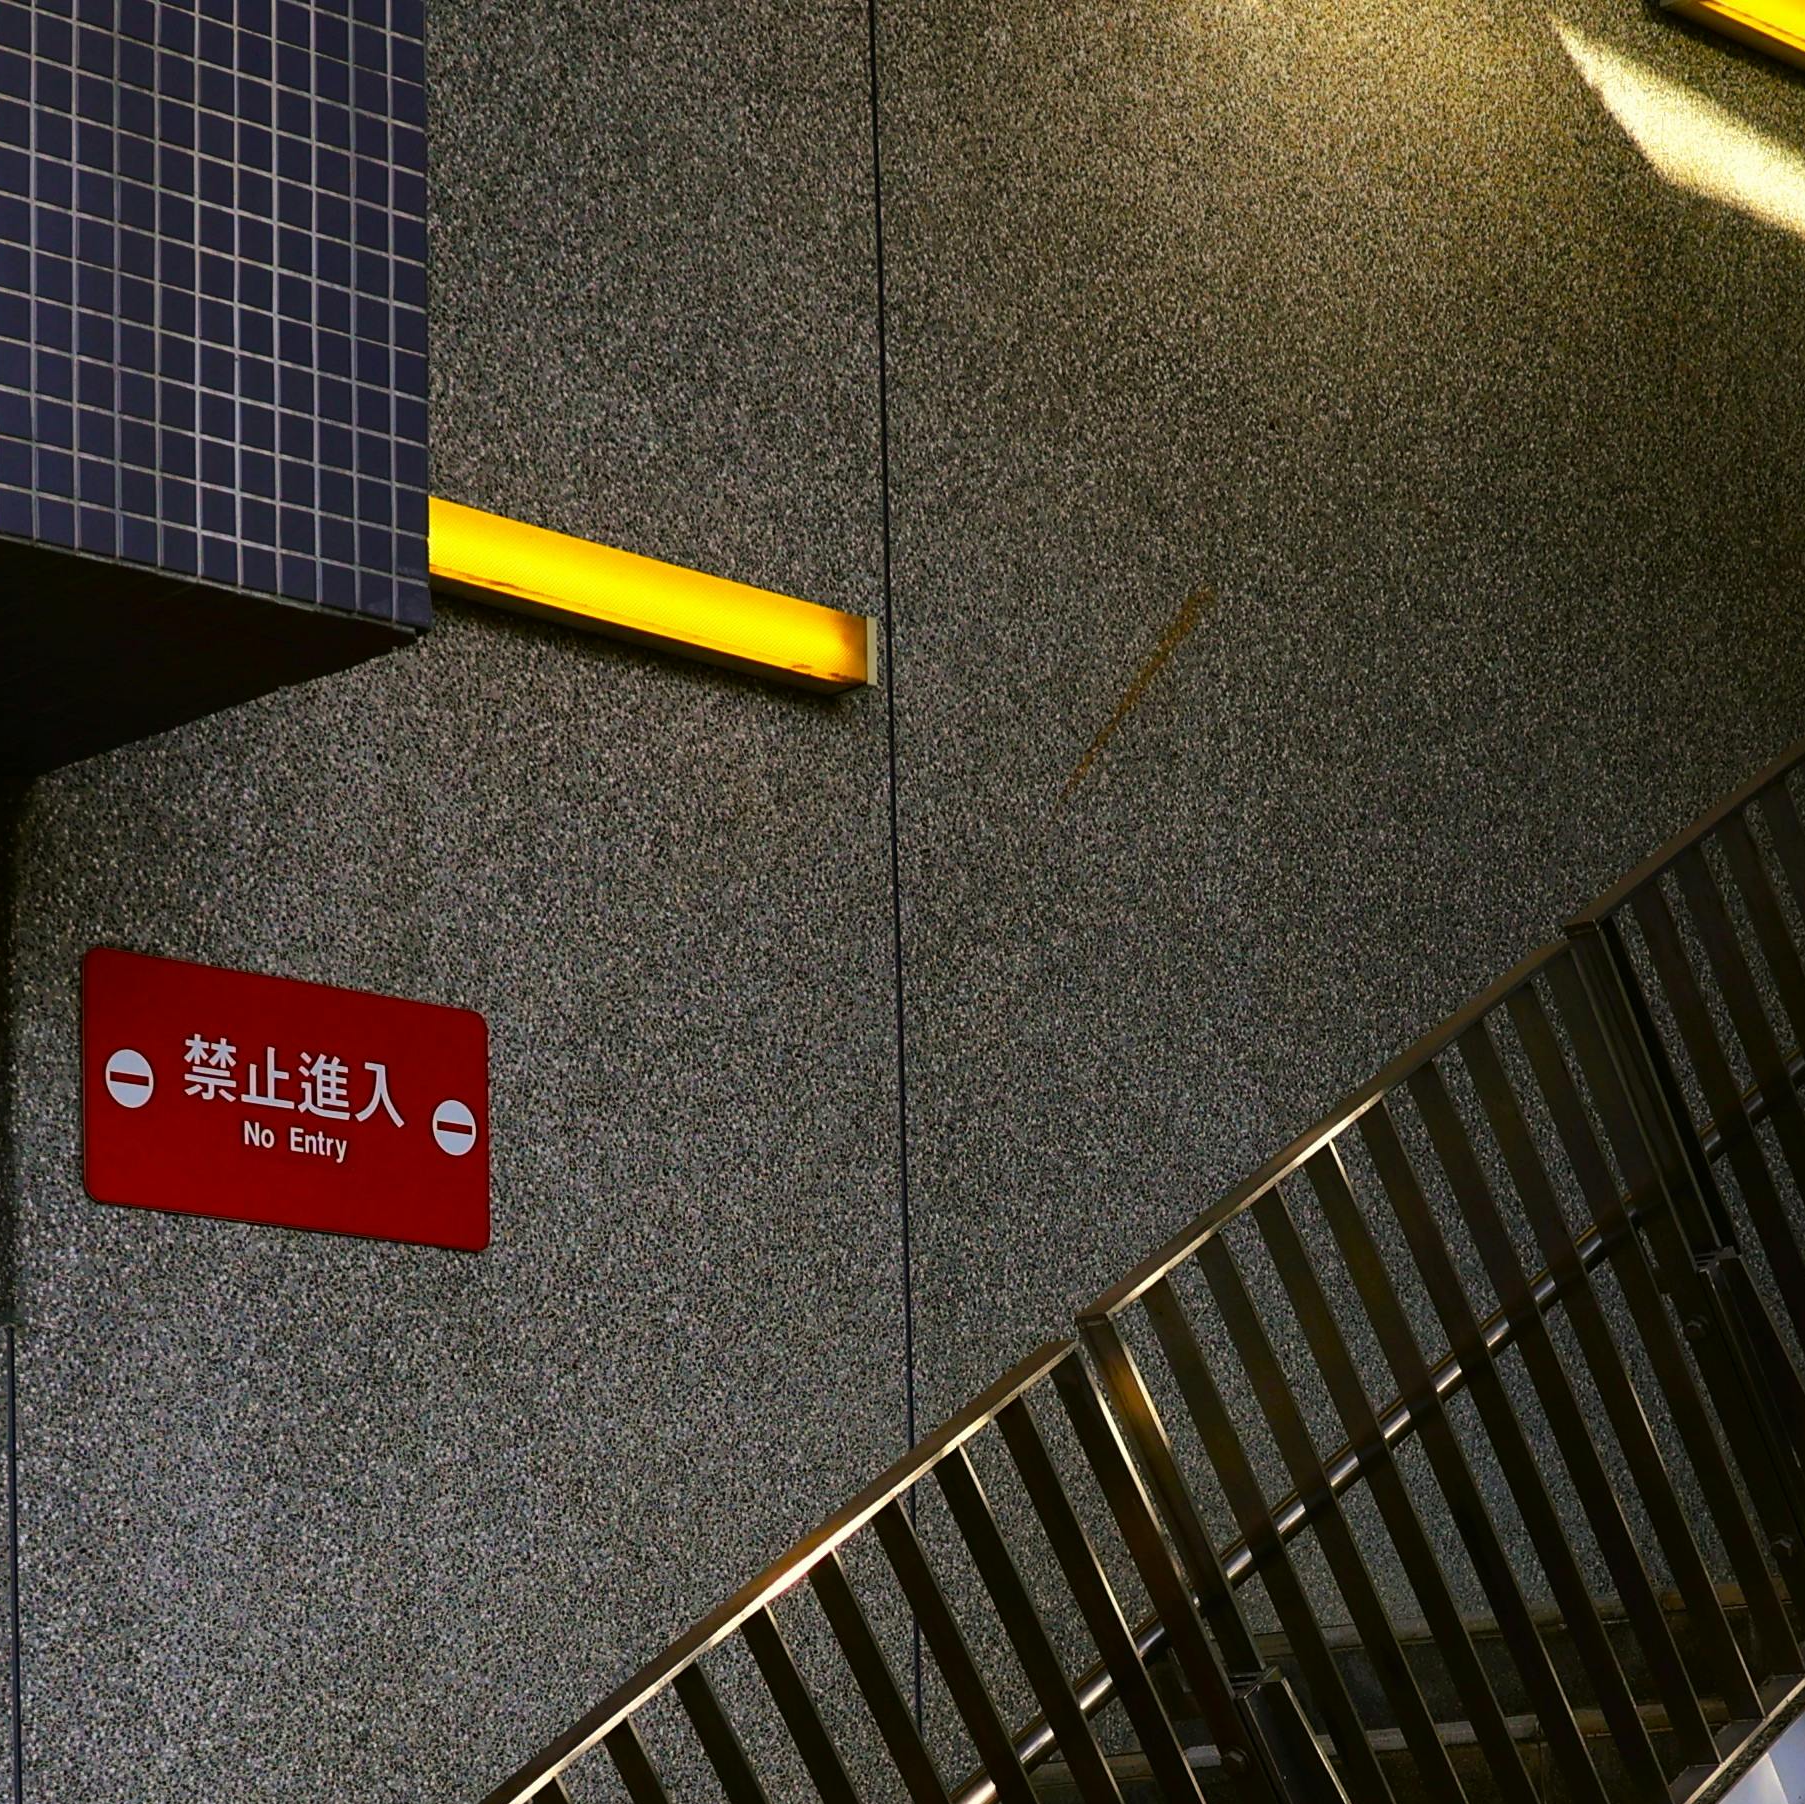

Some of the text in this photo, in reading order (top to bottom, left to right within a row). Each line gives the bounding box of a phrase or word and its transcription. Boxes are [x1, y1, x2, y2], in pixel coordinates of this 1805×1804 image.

[184, 1033, 405, 1129] 禁止進入
[244, 1120, 347, 1164] No Entry
